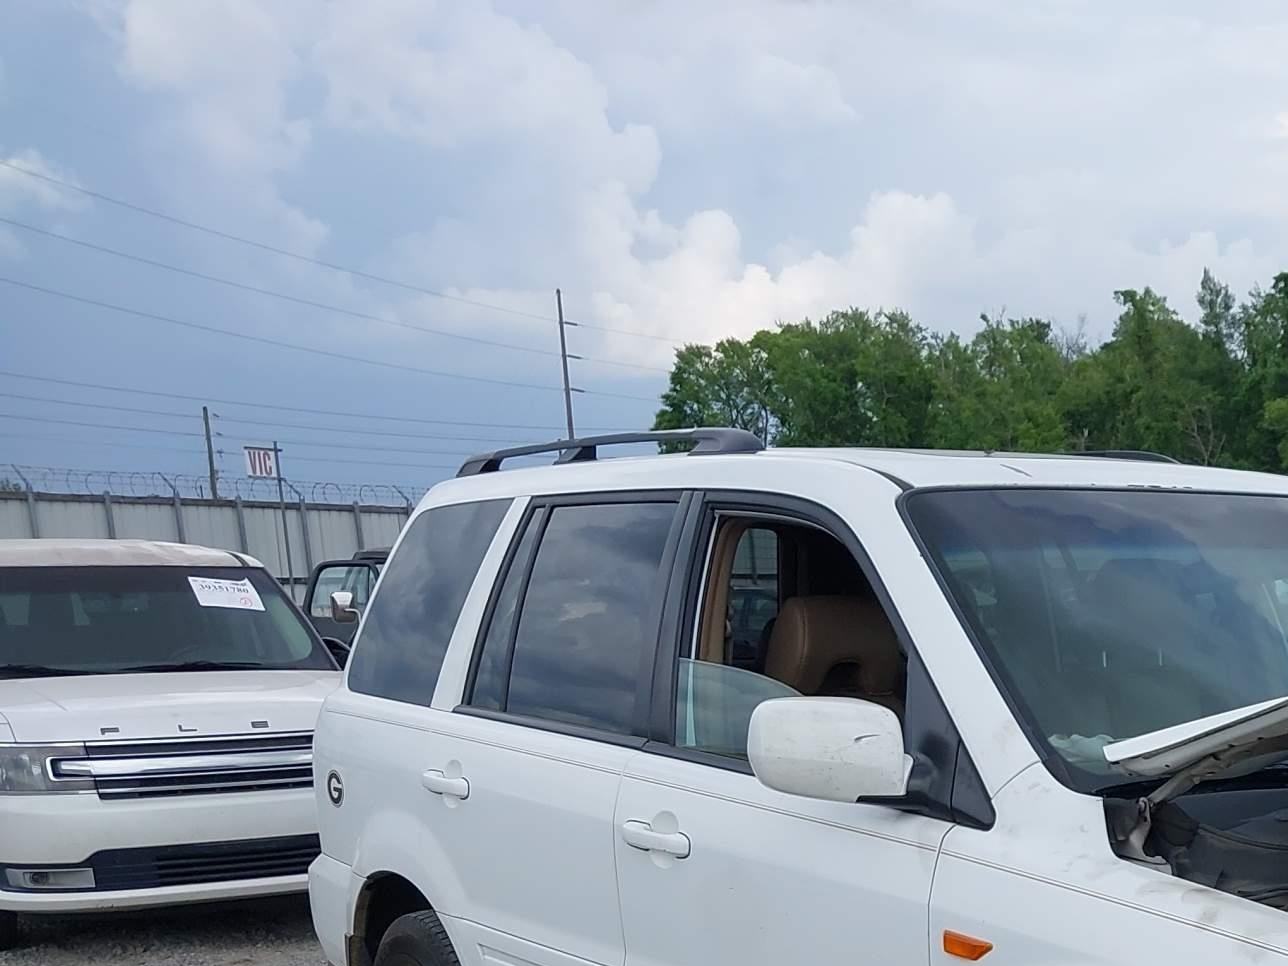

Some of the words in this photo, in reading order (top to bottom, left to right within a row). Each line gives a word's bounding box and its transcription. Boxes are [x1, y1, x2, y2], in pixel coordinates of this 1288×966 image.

[248, 451, 272, 475] VIC
[100, 721, 269, 735] FLE
[327, 770, 344, 807] G
